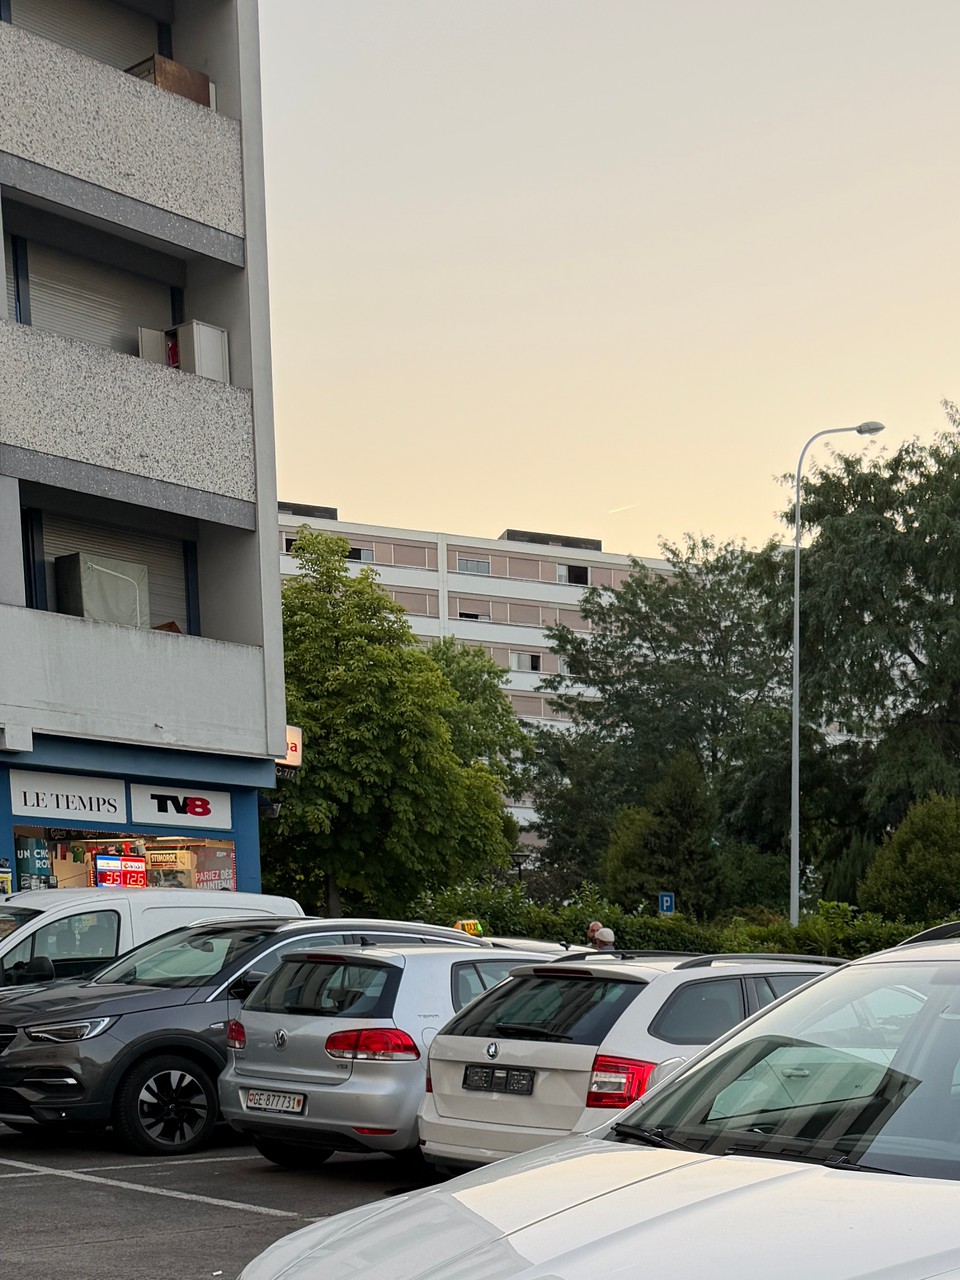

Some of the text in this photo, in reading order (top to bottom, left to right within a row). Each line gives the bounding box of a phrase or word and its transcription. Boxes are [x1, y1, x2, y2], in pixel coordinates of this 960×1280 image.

[22, 791, 118, 814] LE TEMPS
[150, 793, 212, 817] TV8
[17, 849, 31, 859] UN
[105, 872, 121, 885] 35
[126, 873, 145, 886] 126
[195, 870, 220, 882] PARIEZ
[663, 896, 671, 911] P
